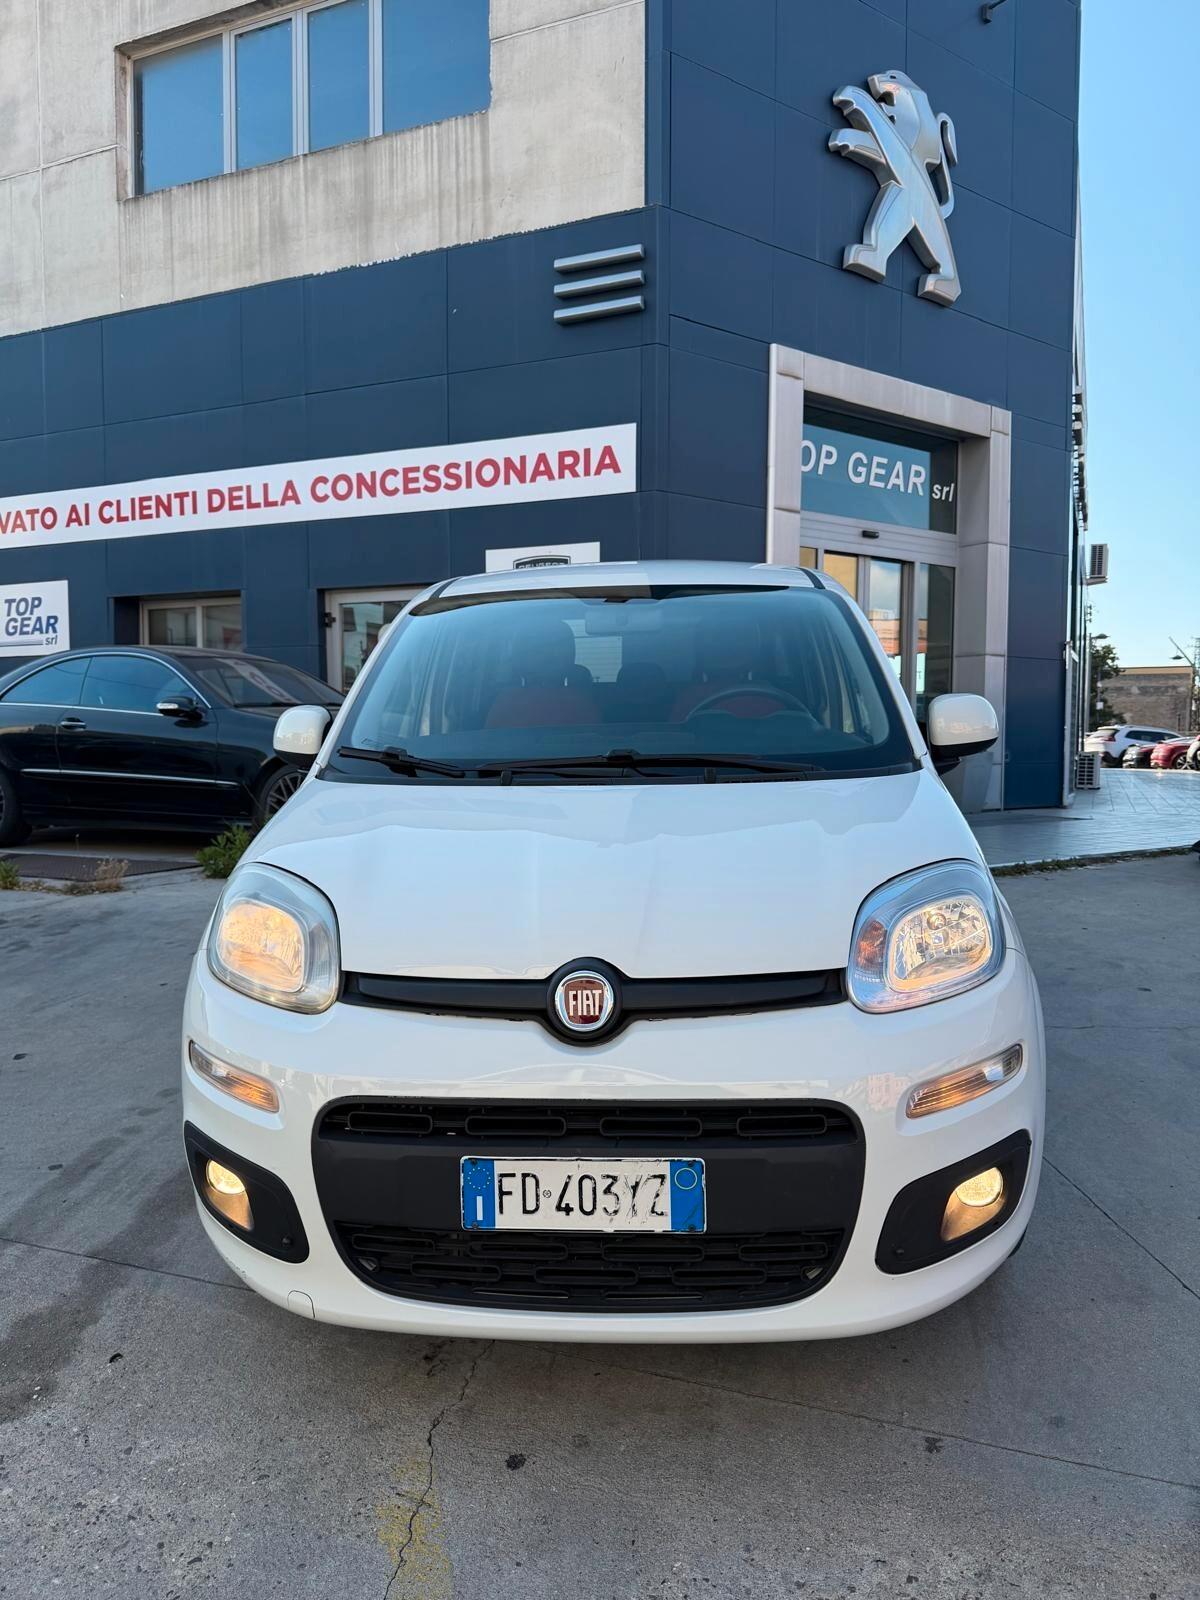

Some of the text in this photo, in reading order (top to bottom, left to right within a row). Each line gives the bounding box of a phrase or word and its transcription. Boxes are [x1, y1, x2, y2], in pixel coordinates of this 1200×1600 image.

[0, 445, 622, 534] VATO AI CLIENTI DELLA CONCESSIONARIA
[848, 452, 926, 496] GEAR
[932, 482, 954, 502] srl
[4, 597, 42, 617] TOP
[5, 615, 58, 636] GEAR
[45, 635, 58, 645] srl
[568, 990, 602, 1017] FIAT
[498, 1172, 540, 1215] FD
